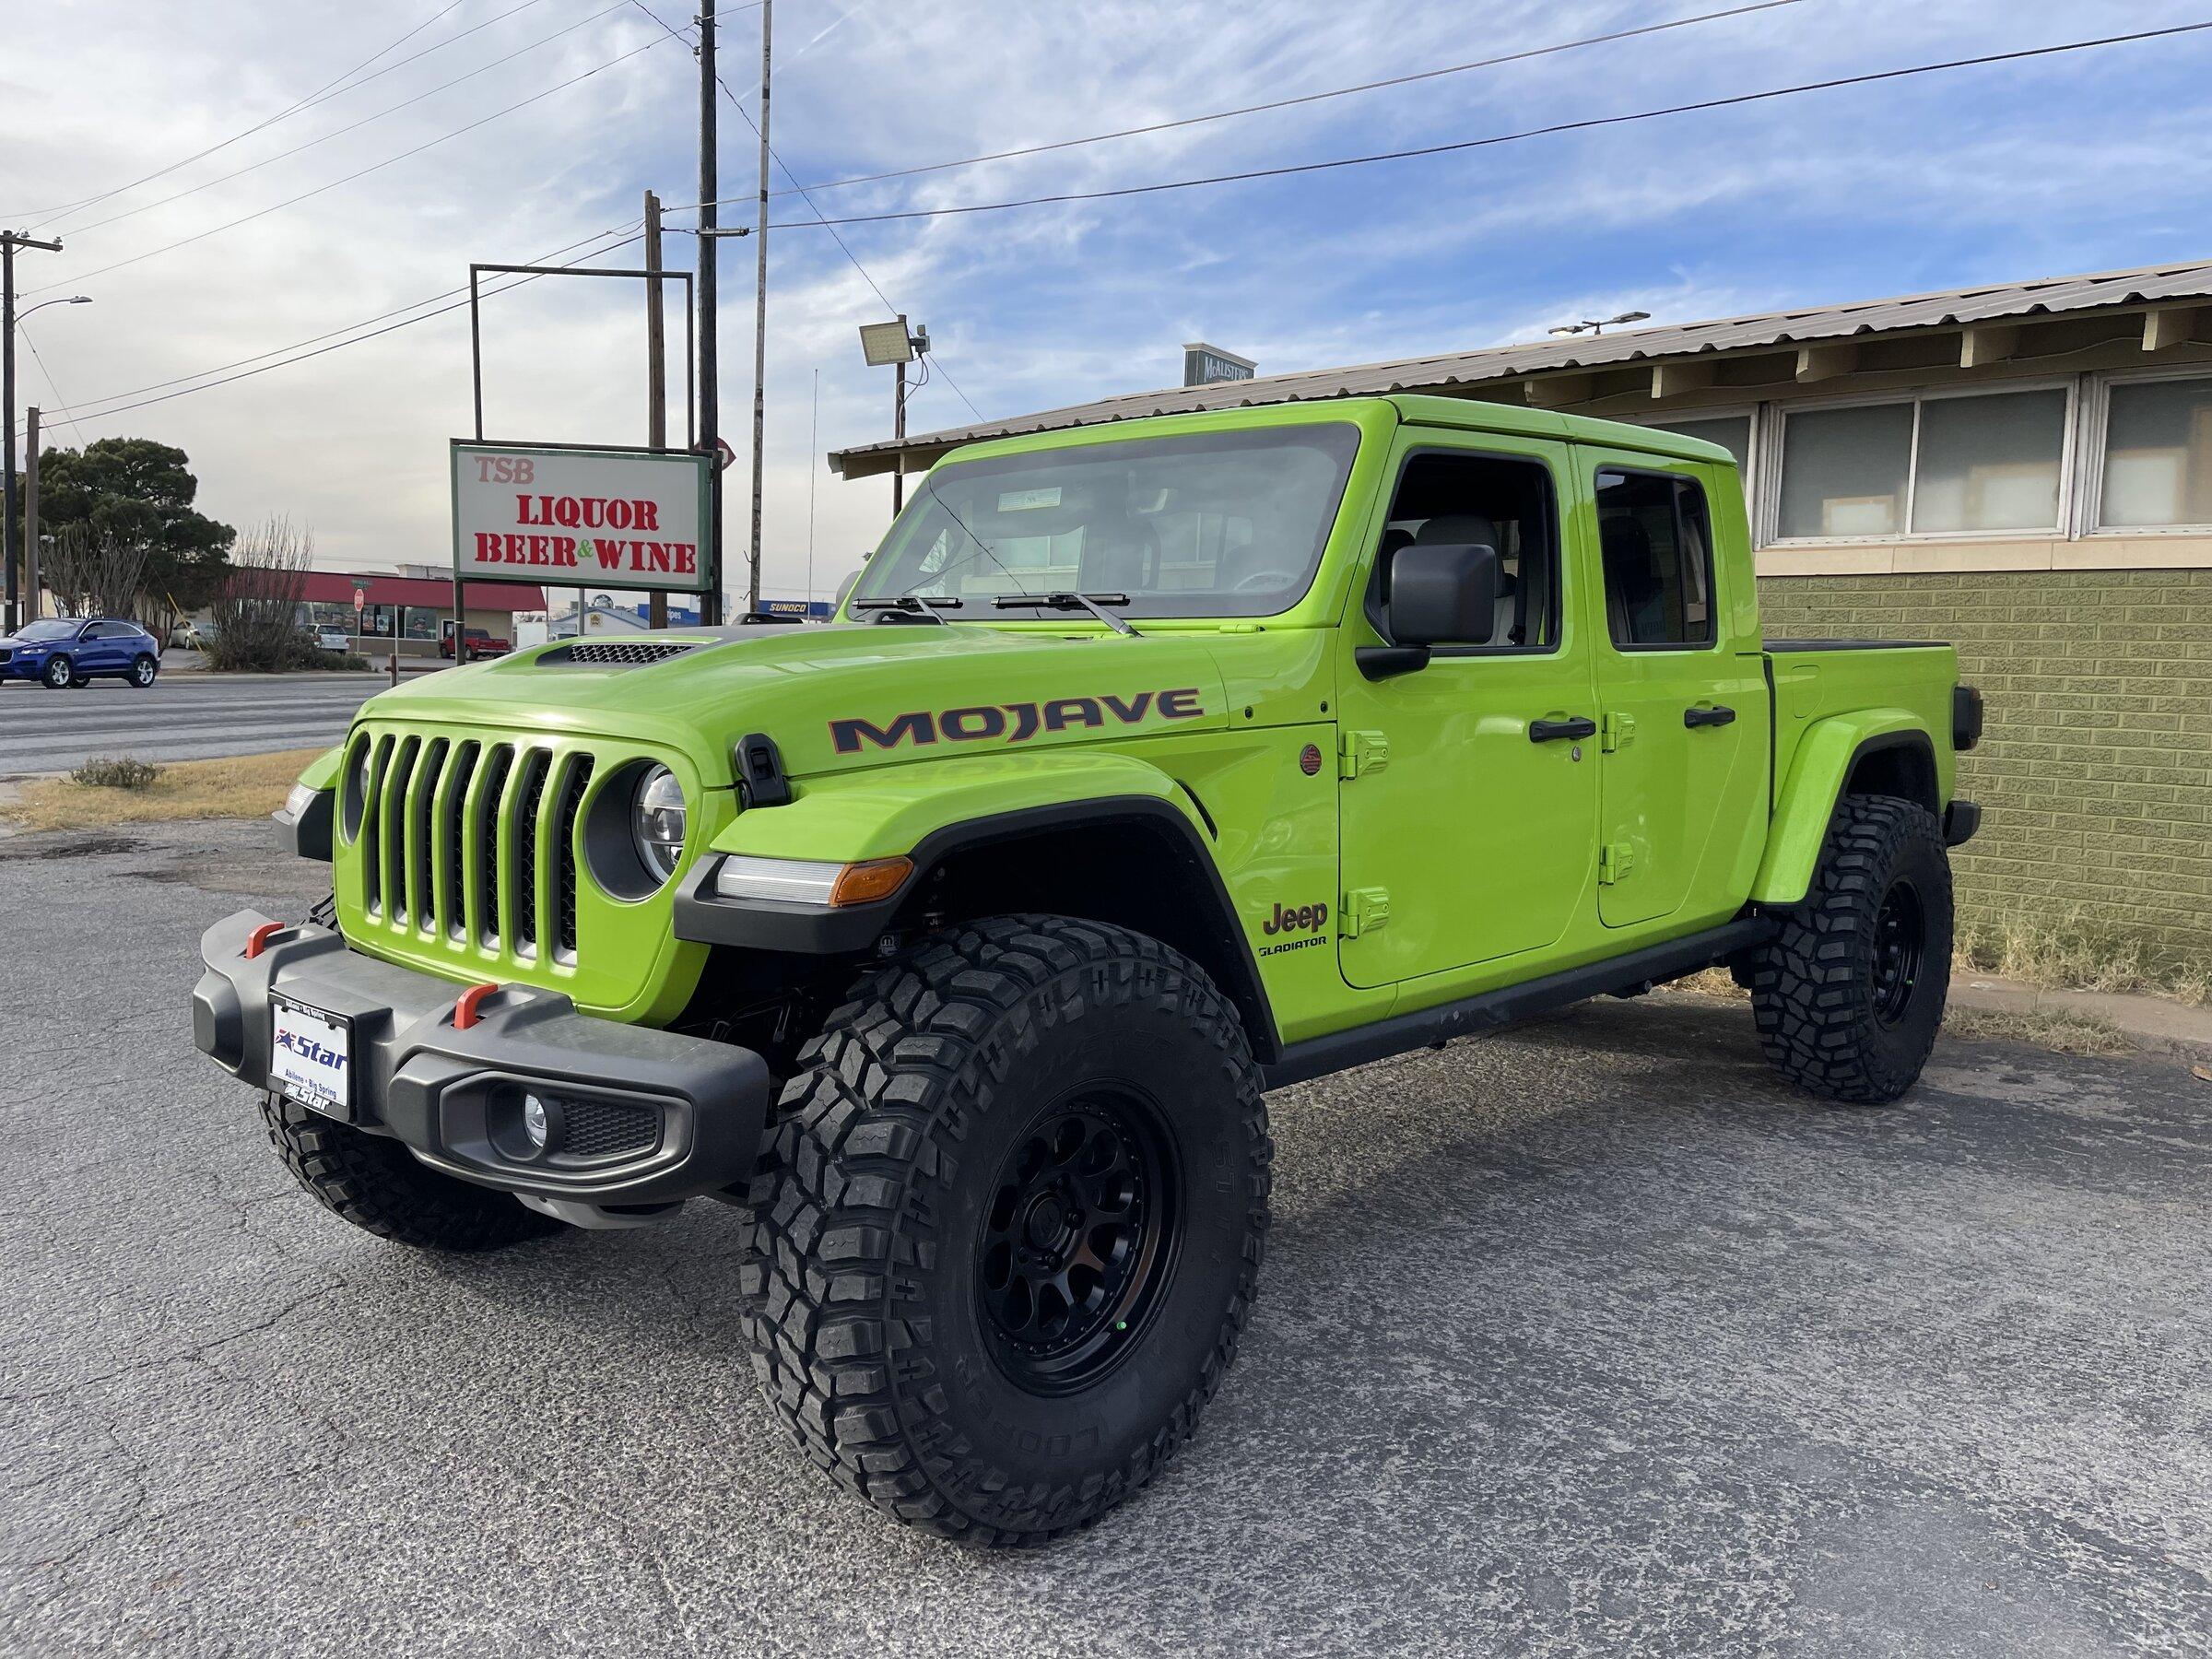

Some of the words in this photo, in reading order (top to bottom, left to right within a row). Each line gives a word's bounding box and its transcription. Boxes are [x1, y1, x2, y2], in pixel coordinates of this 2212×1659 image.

[474, 455, 535, 485] TSB
[516, 494, 660, 532] LIQUOR
[474, 532, 578, 568] BEER
[593, 538, 696, 574] WINE
[769, 603, 807, 613] SUNOCO
[827, 686, 1206, 755] MOJAVE
[1263, 902, 1328, 935] Jeep
[1258, 935, 1327, 957] GLADIATOR
[293, 1035, 348, 1071] Star
[285, 1068, 304, 1085] Abilene
[309, 1078, 318, 1093] Big
[318, 1082, 337, 1100] Spring
[296, 1088, 331, 1111] Star
